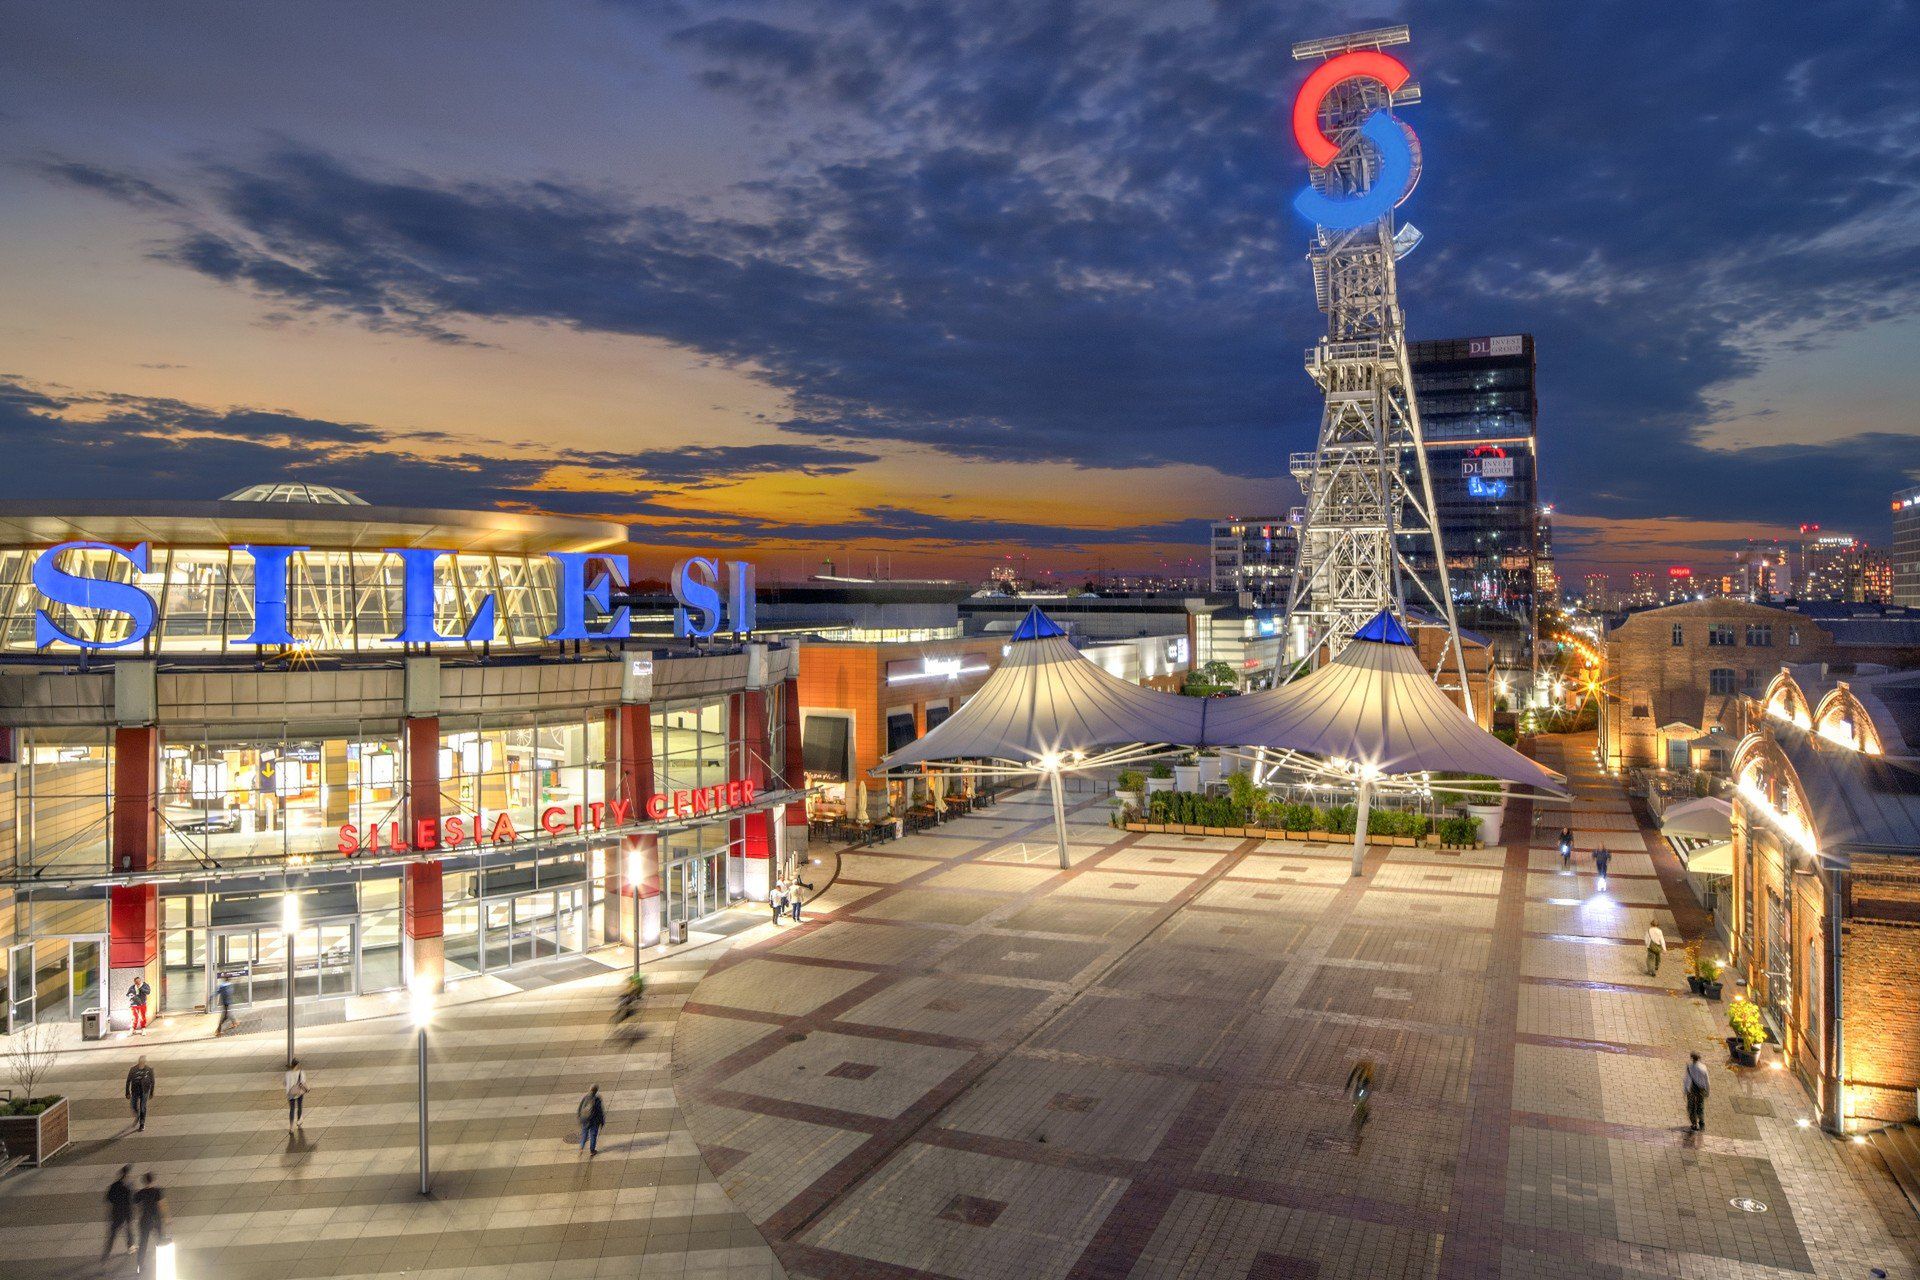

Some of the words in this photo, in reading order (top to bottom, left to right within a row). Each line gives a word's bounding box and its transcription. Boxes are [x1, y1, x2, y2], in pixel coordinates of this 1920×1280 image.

[1492, 338, 1520, 346] INVEST
[1470, 342, 1490, 354] DL
[1492, 345, 1521, 353] GROUP
[1464, 463, 1482, 474] DL
[339, 813, 517, 855] SILESIA
[542, 799, 631, 835] CITY
[646, 779, 755, 820] CENTER
